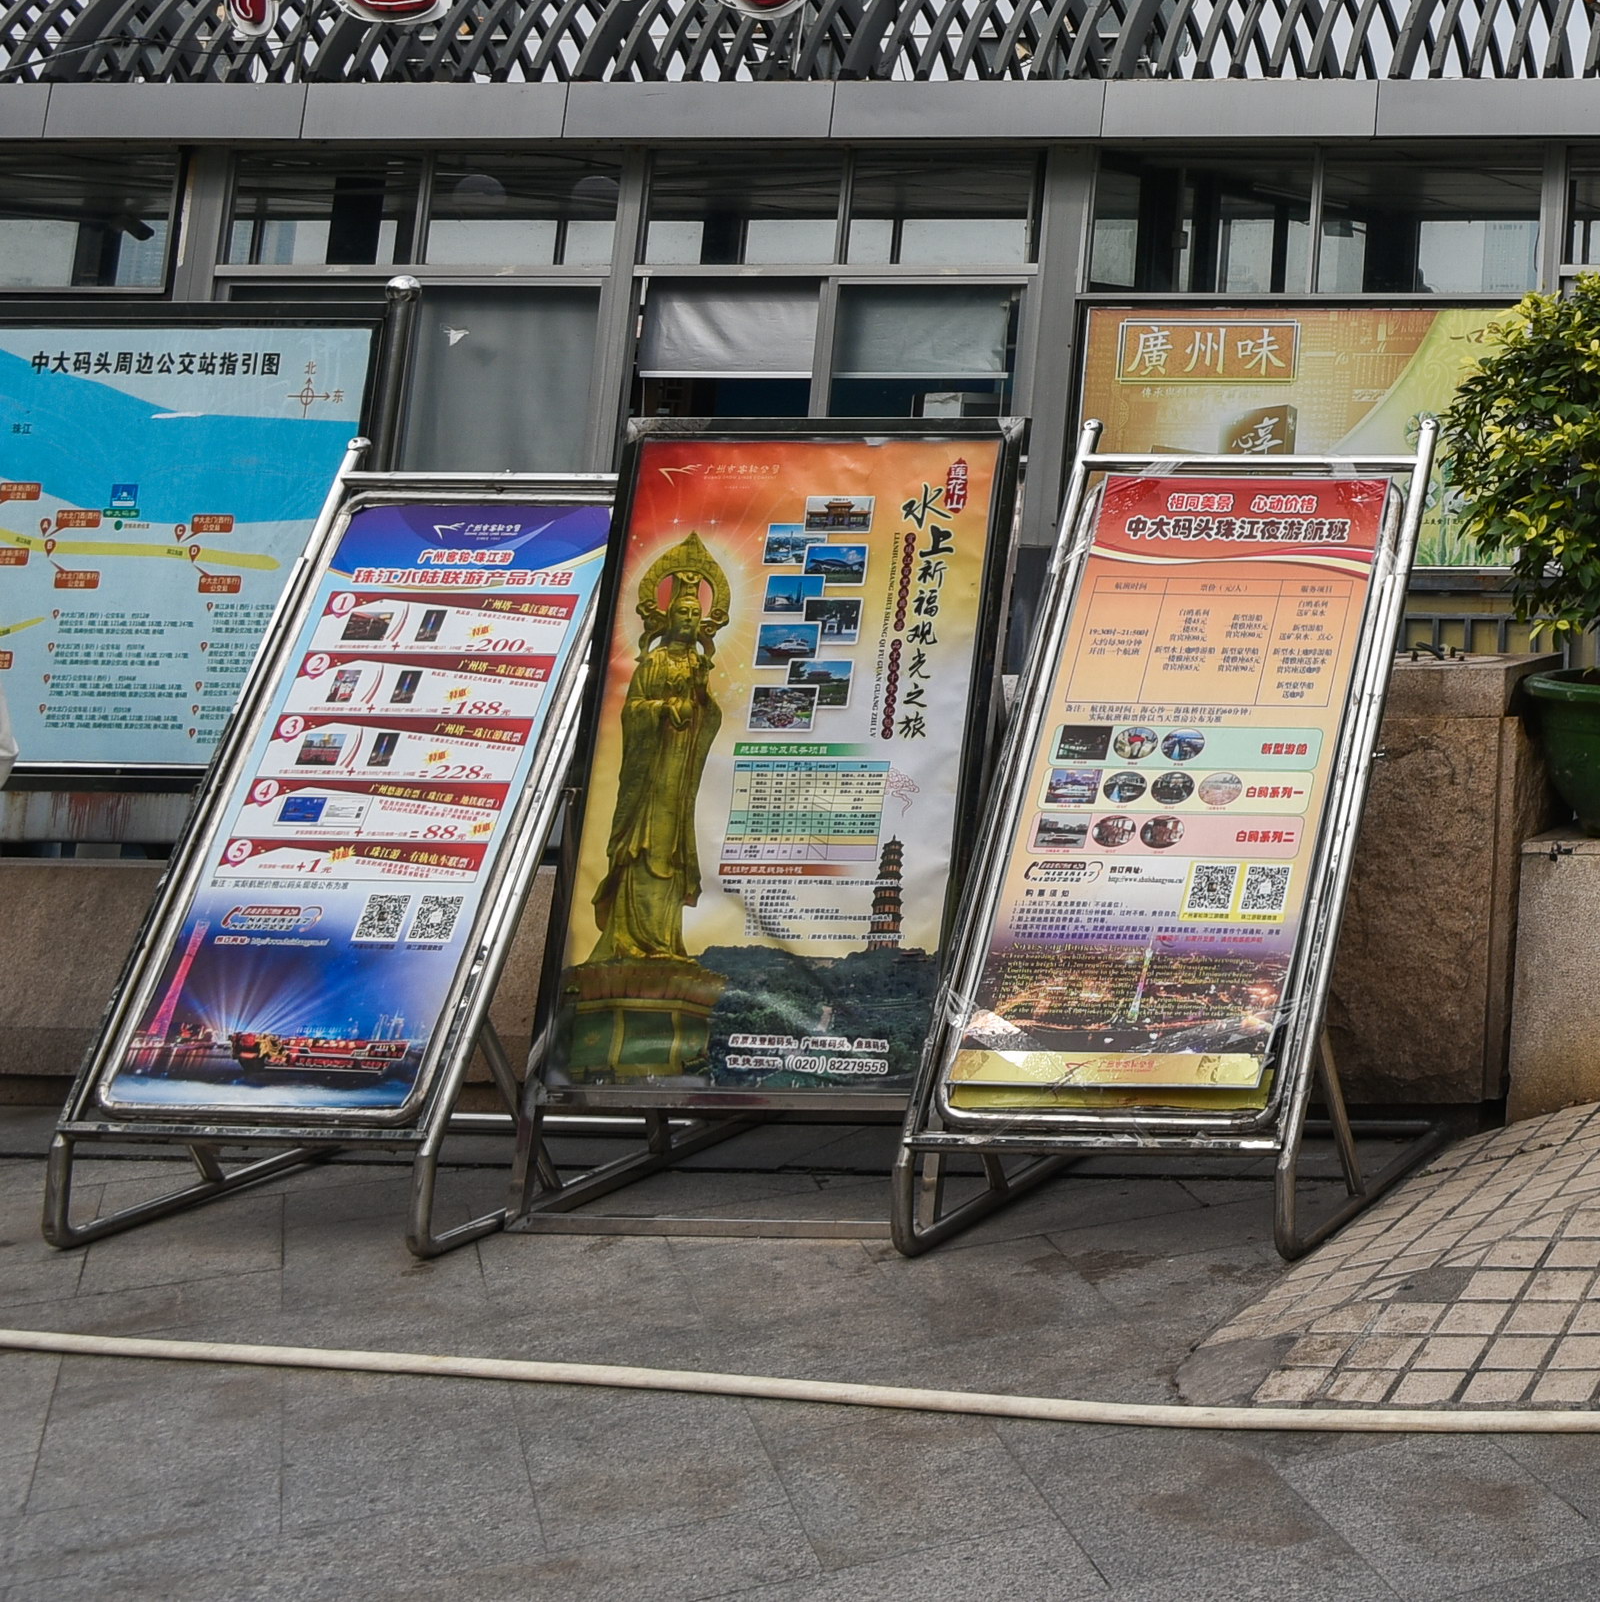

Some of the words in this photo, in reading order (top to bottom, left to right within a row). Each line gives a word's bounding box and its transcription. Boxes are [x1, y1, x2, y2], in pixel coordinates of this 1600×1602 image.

[1127, 326, 1285, 377] 廣州味
[31, 350, 281, 376] 中大码头周边公交站指引图
[304, 361, 317, 375] 北
[332, 389, 344, 403] 东
[12, 423, 32, 435] 珠江
[1168, 494, 1234, 512] 相同美景
[1250, 495, 1318, 513] 心动价格
[1126, 516, 1351, 542] 中大码头珠江夜游航班
[418, 550, 514, 564] 广州客轮·珠江游
[352, 568, 574, 586] 珠江水陆联游产品介绍
[1114, 582, 1147, 591] 航班时间
[897, 484, 956, 739] 水上祈福观光之旅
[1261, 743, 1308, 755] 新型游船
